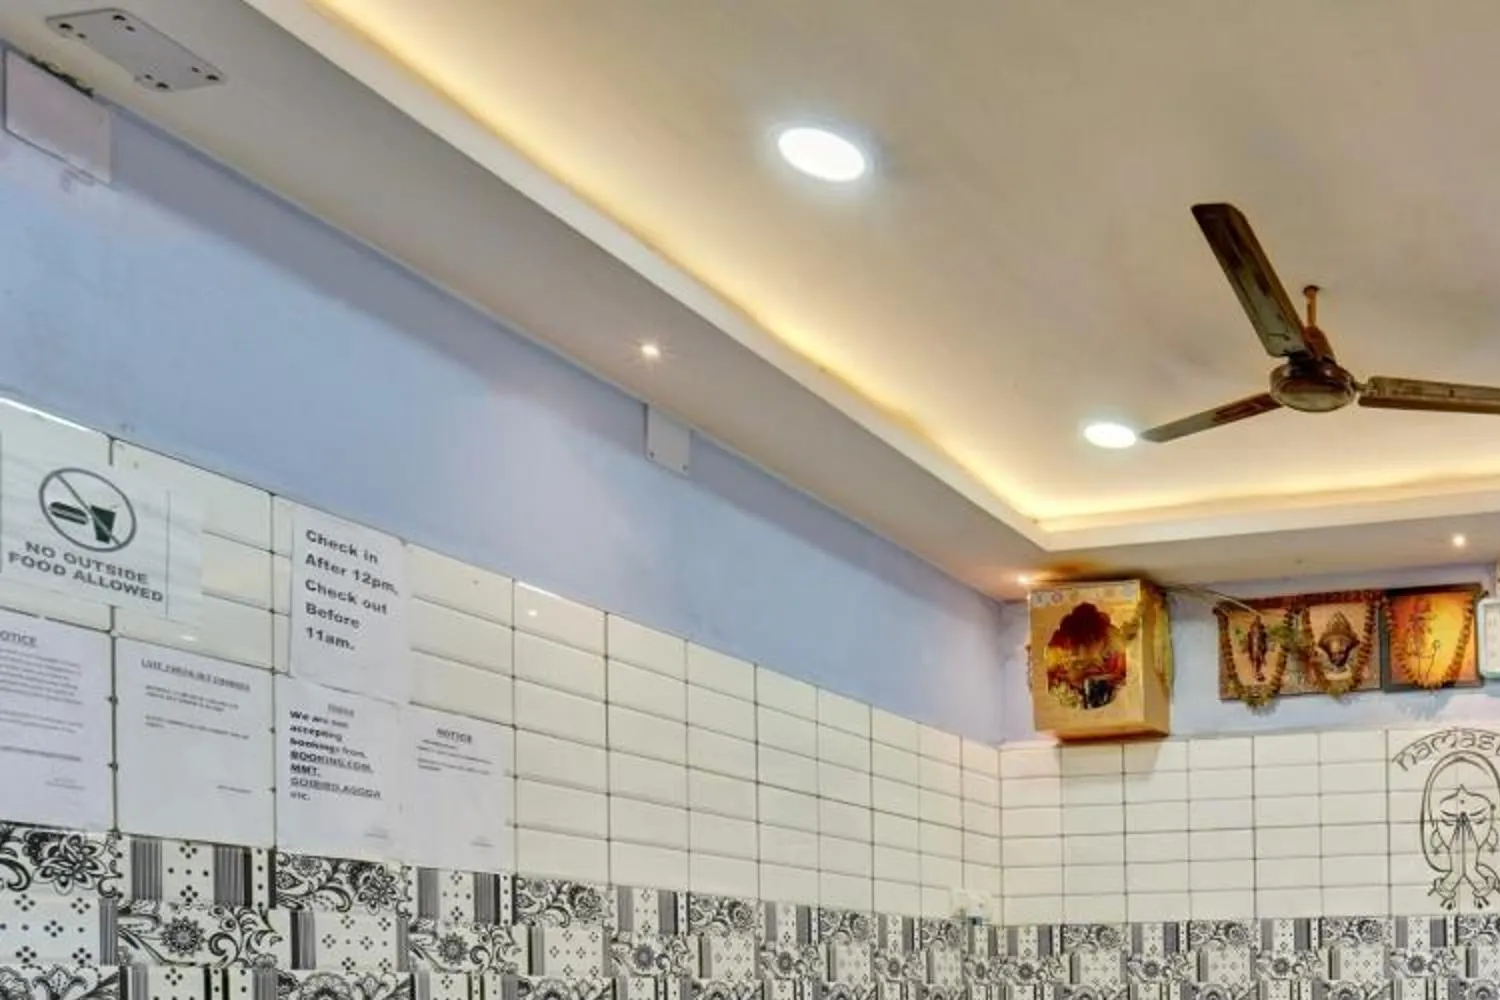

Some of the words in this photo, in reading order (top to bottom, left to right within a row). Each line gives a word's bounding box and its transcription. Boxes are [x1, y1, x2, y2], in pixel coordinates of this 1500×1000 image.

[25, 541, 57, 559] NO
[63, 551, 149, 585] OUTSIDE
[305, 528, 358, 557] Check
[363, 549, 378, 564] in
[8, 551, 67, 576] FOOD
[72, 569, 164, 602] ALLOWED
[305, 553, 348, 576] After
[305, 579, 358, 605] Check
[362, 599, 388, 615] out
[306, 601, 361, 629] Before
[0, 628, 38, 647] OTICE
